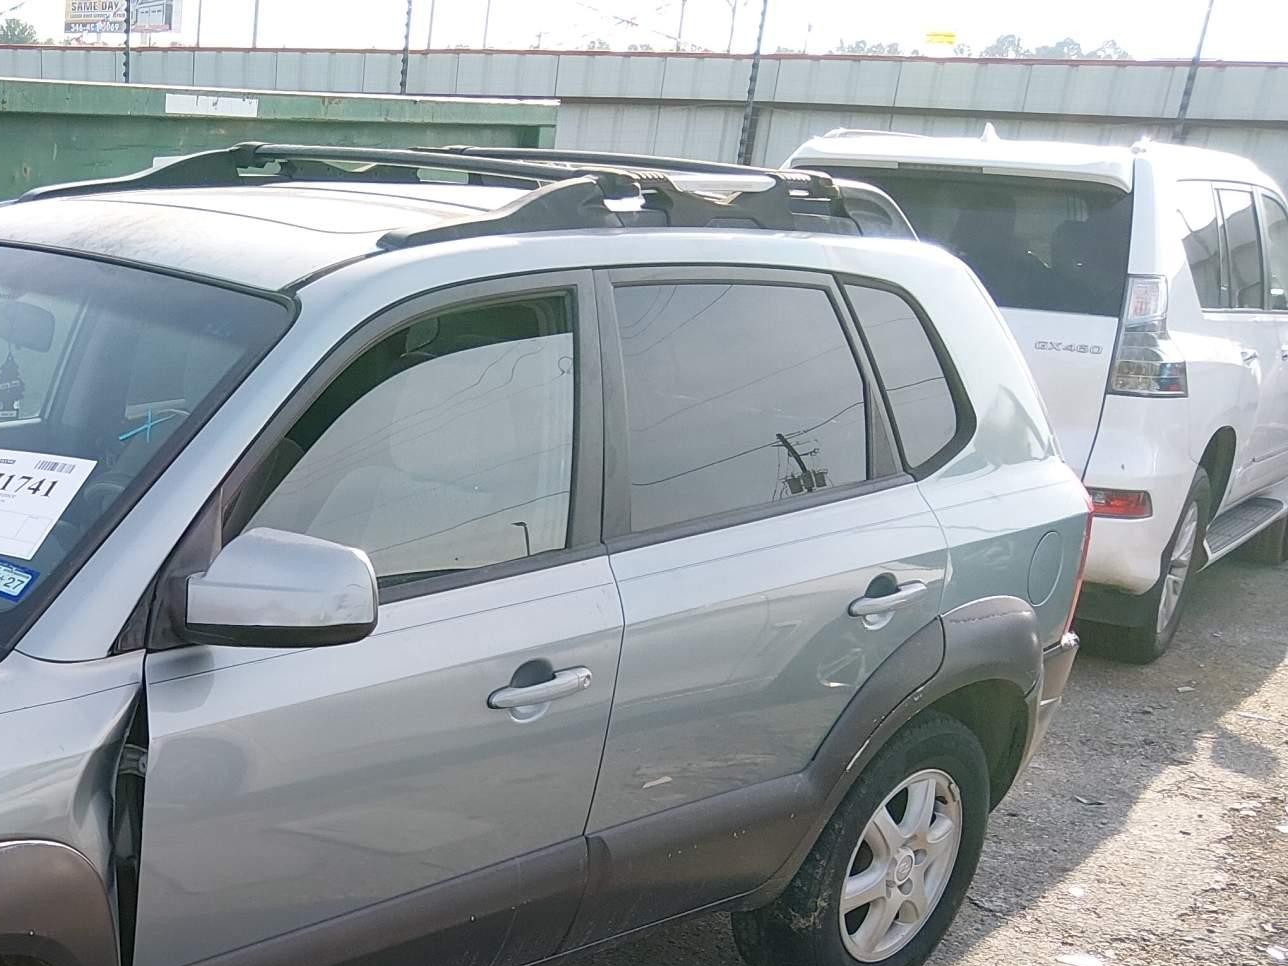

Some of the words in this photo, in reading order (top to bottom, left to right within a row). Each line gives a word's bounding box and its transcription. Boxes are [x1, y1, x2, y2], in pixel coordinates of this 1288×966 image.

[72, 1, 98, 11] SAME
[101, 1, 119, 11] DAY
[3, 576, 25, 590] 27
